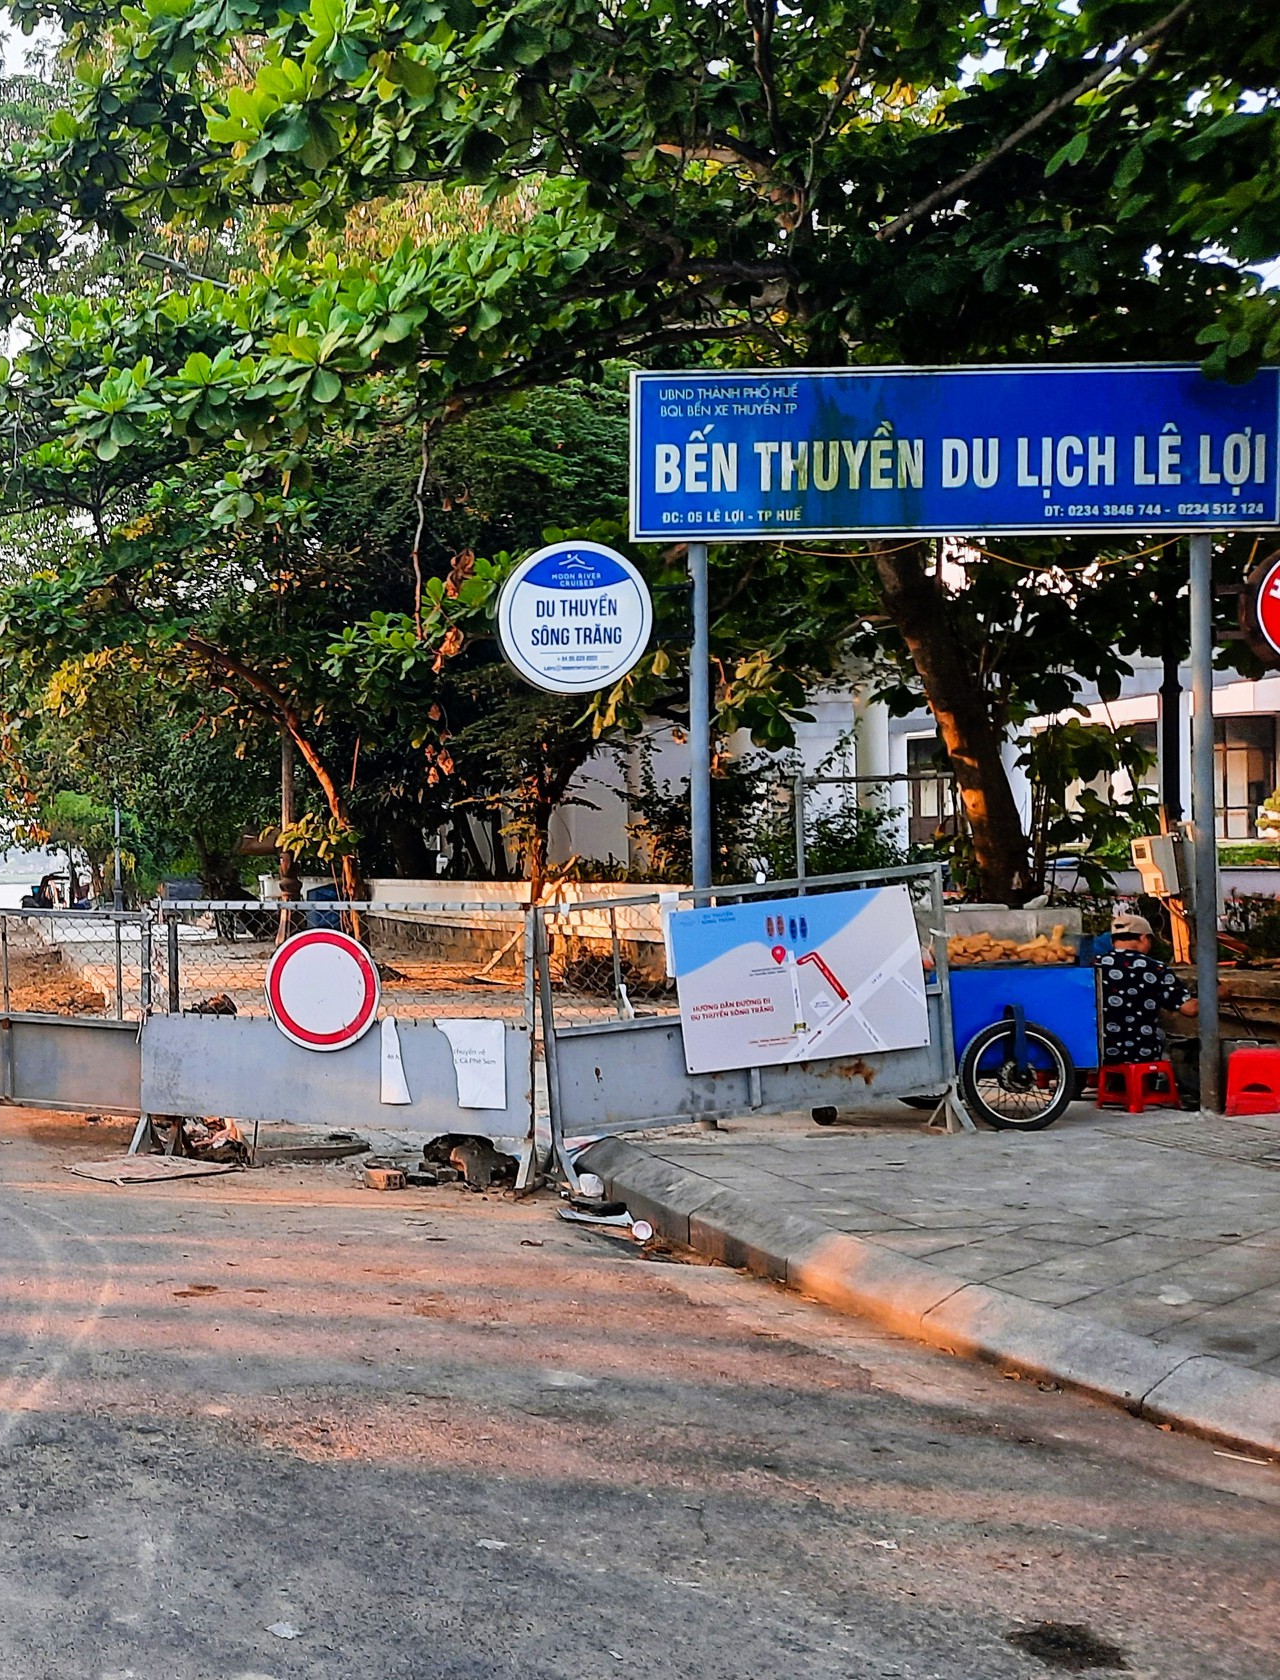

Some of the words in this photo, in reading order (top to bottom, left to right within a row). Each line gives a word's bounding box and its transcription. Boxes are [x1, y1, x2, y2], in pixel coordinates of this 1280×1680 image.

[659, 389, 694, 400] UBND
[697, 385, 740, 400] THÀNH
[743, 382, 770, 399] PHỐ
[660, 405, 683, 417] BQL
[687, 400, 711, 416] BẾN
[714, 404, 729, 416] XE
[784, 403, 798, 414] TP
[655, 423, 737, 493] BẾN
[754, 420, 924, 492] THUYỀN
[942, 438, 999, 489] DU
[1017, 436, 1115, 499] LỊCH
[1134, 422, 1181, 485] LÊ
[1199, 427, 1266, 496] LỢI
[687, 511, 702, 522] 05
[707, 508, 721, 522] LÊ
[724, 509, 744, 524] LỢI
[757, 510, 772, 521] TP
[776, 506, 802, 521] HUẾ
[1069, 505, 1099, 516] 0234
[1103, 504, 1134, 516] 3846
[1139, 504, 1161, 516] 744
[1178, 504, 1209, 515] 0234
[1212, 503, 1236, 515] 512
[1241, 503, 1264, 514] 124
[536, 600, 555, 618] DU
[560, 593, 617, 617] THUYỀN
[531, 625, 570, 646] SÔNG
[574, 623, 622, 645] TRĂNG
